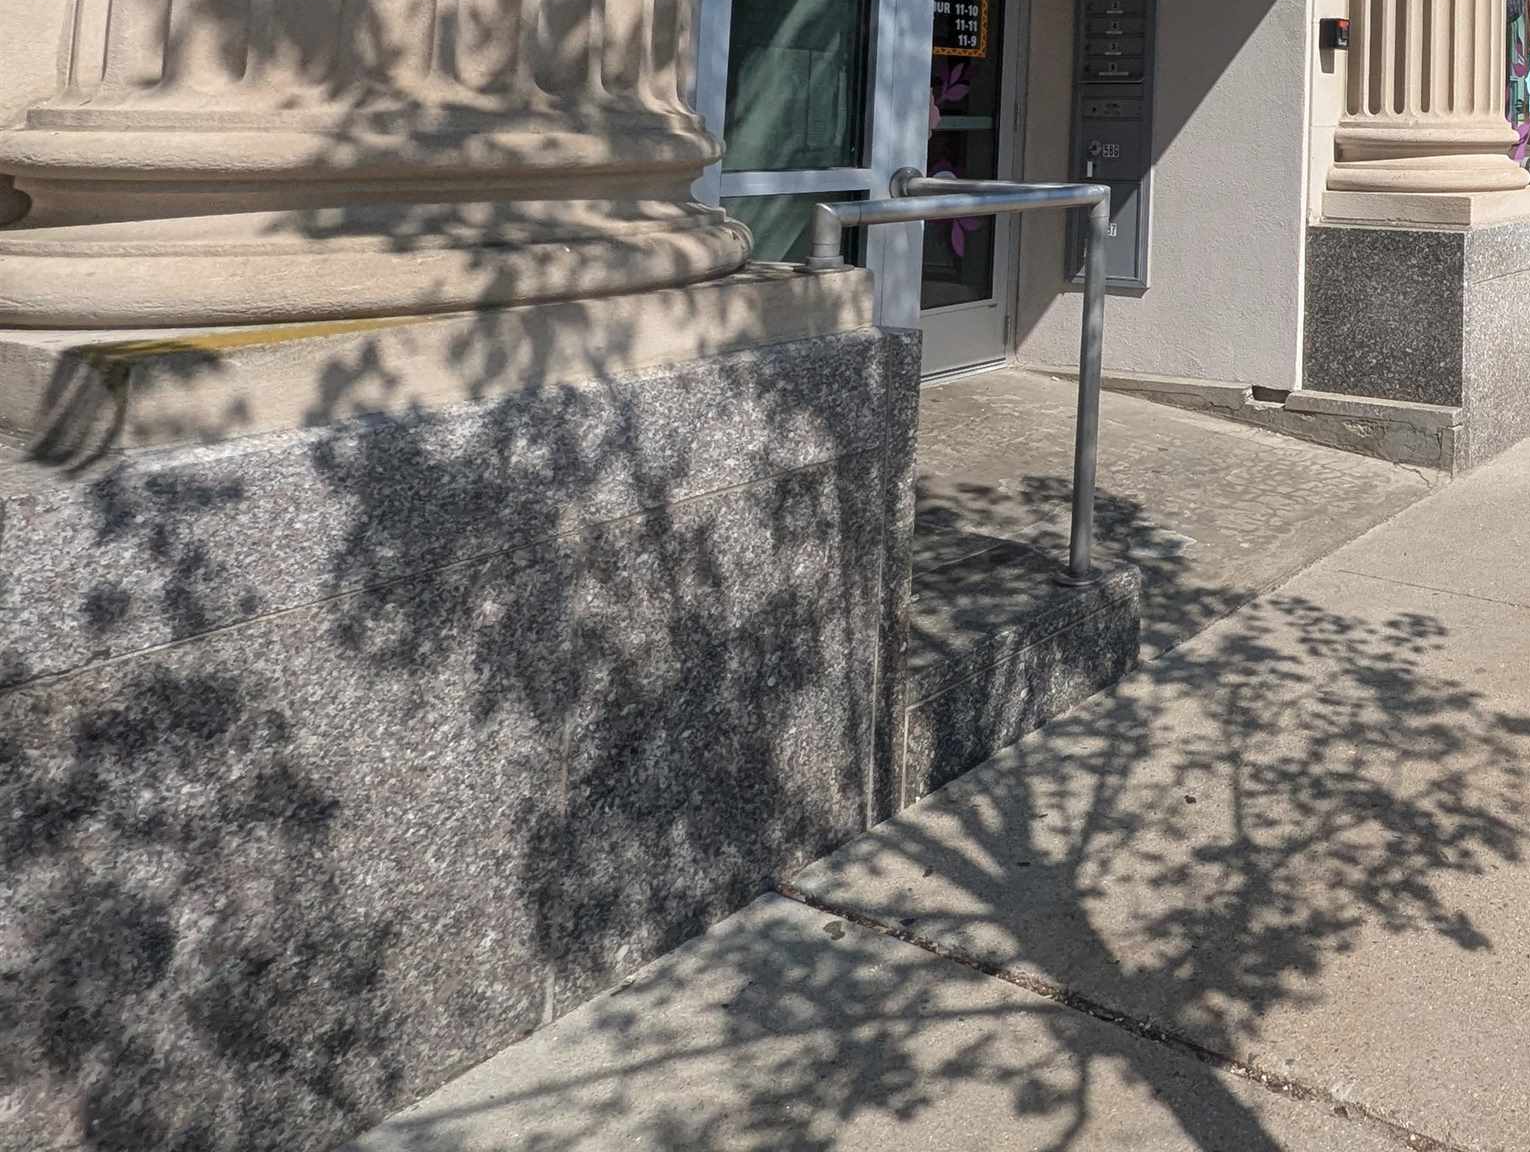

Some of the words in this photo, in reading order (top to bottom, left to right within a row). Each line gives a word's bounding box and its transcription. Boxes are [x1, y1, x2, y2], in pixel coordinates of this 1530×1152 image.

[955, 3, 979, 17] 11-10
[955, 18, 978, 32] 11-11
[958, 34, 977, 47] 11-9
